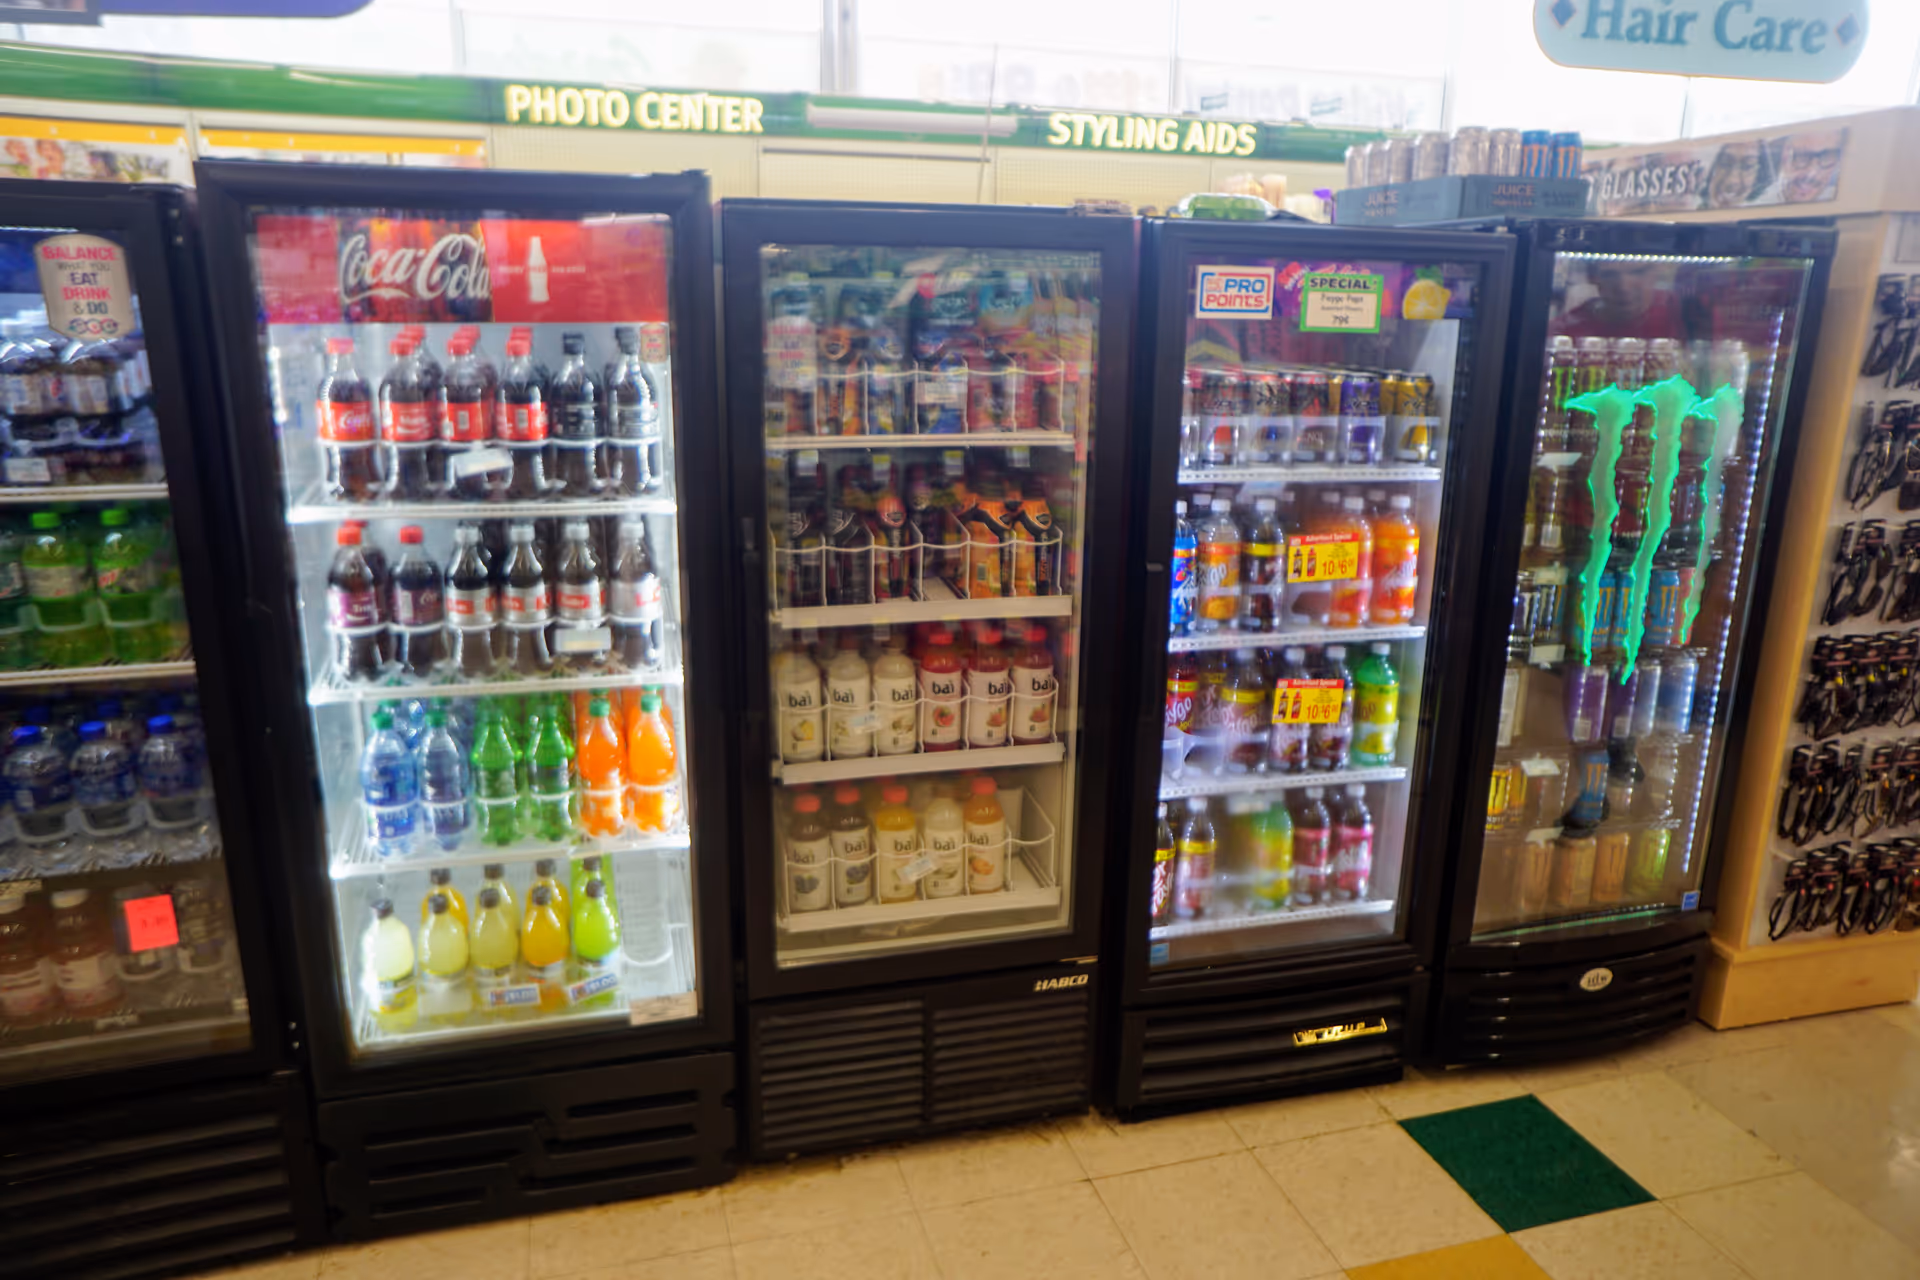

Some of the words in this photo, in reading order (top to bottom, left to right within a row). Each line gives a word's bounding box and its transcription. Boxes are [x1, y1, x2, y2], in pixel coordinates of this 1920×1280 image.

[1580, 0, 1697, 45] Hair
[1713, 0, 1828, 54] Care
[504, 84, 631, 128] PHOTO
[633, 91, 764, 133] CENTER
[1047, 112, 1179, 151] STYLING
[1181, 120, 1257, 156] AIDS
[1493, 184, 1536, 197] JUICE
[42, 245, 117, 261] BALANCE
[340, 233, 491, 304] Coca-Cola
[70, 272, 98, 285] EAT
[1224, 278, 1265, 293] PRO
[62, 286, 112, 301] DRINK
[86, 301, 108, 315] DO
[932, 680, 955, 695] bai
